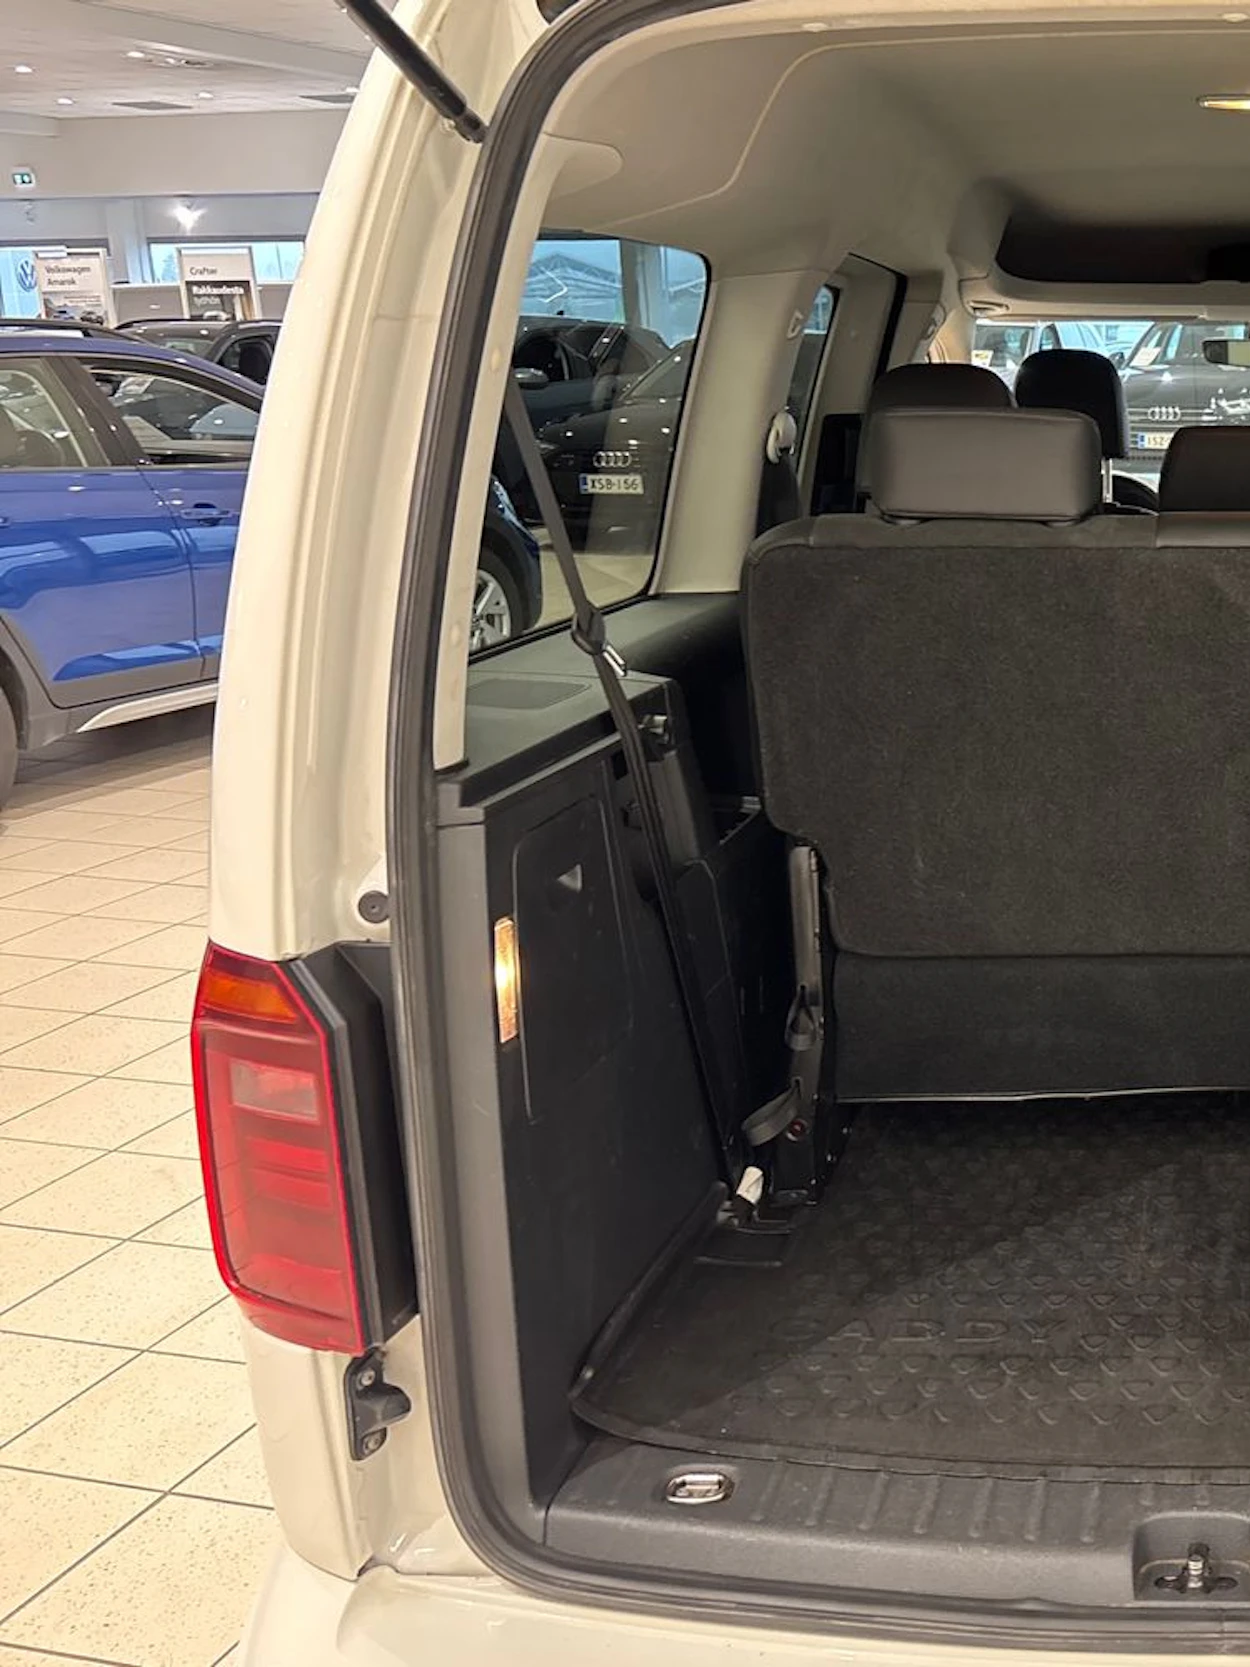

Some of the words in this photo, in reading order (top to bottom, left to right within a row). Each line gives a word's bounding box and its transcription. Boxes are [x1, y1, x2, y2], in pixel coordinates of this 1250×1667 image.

[45, 266, 91, 275] Volkswagen
[189, 267, 217, 275] Crafter
[47, 278, 76, 286] Amarok
